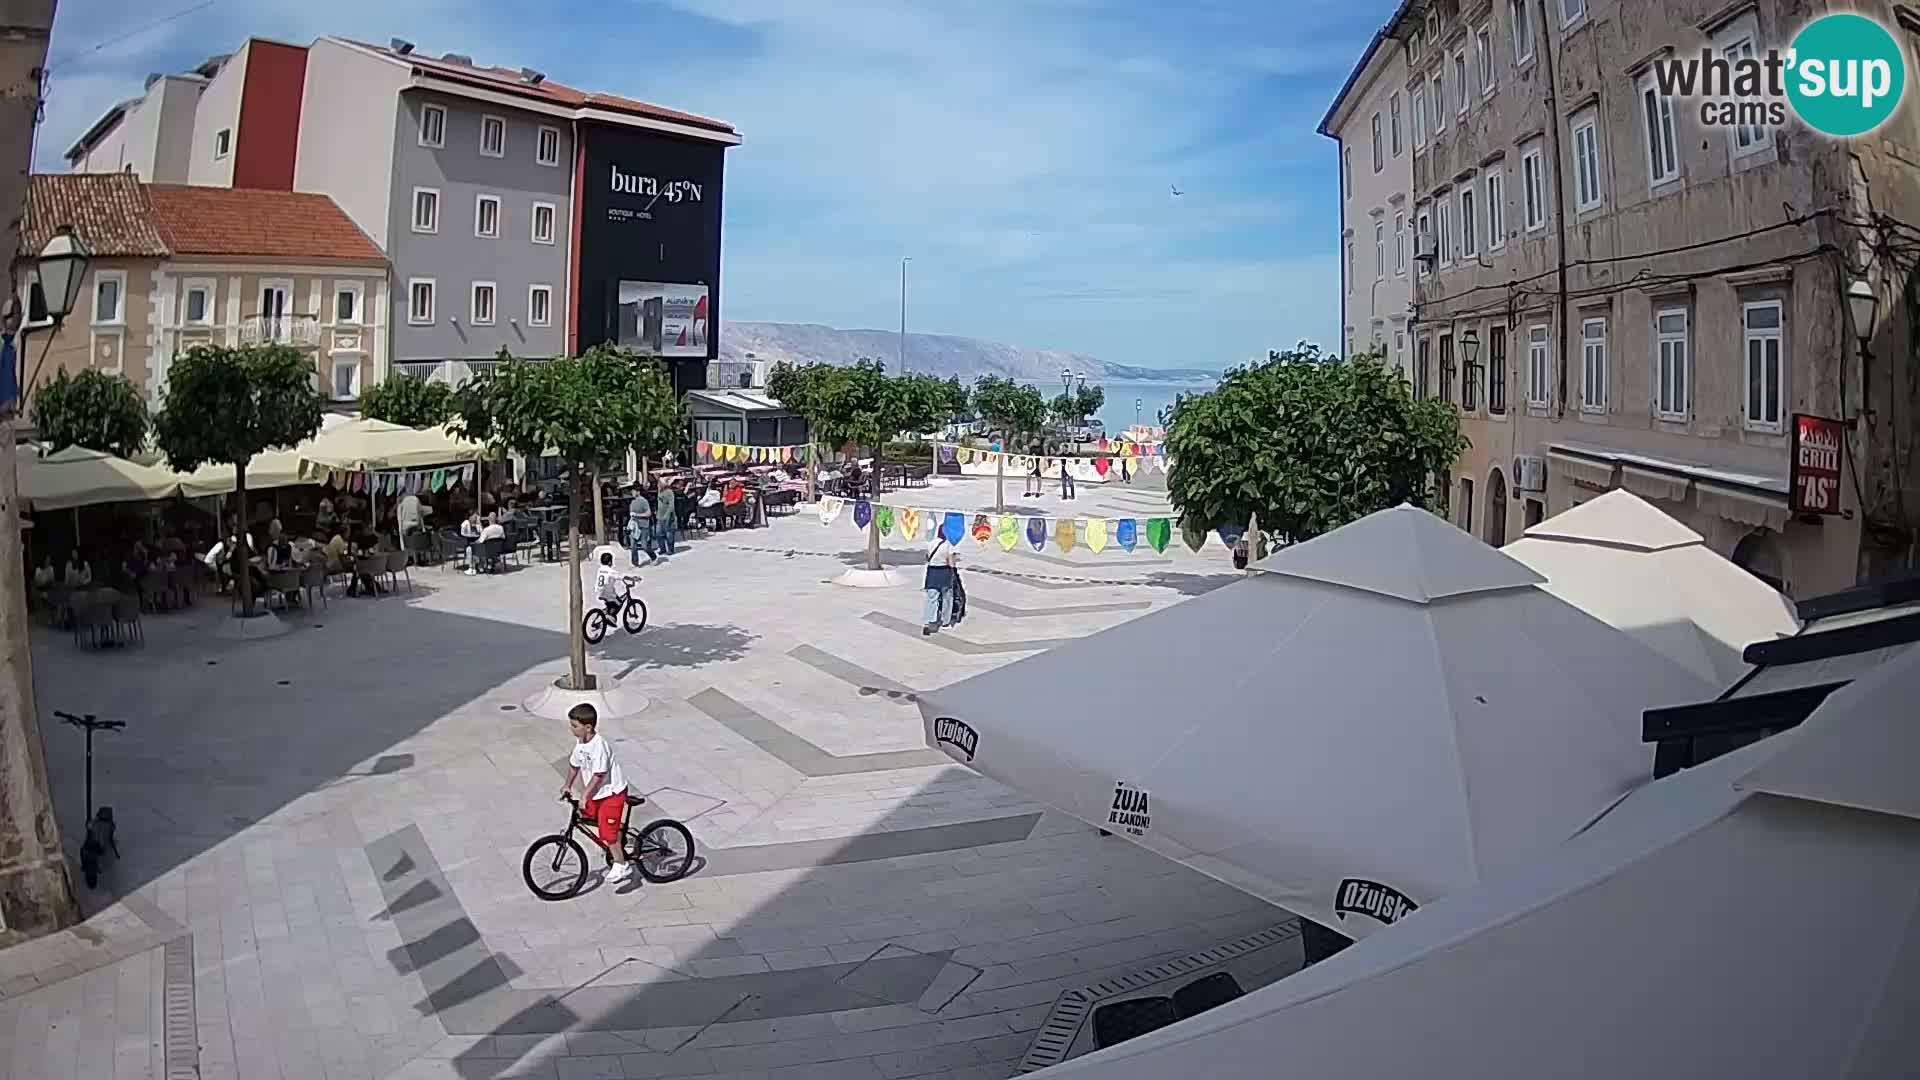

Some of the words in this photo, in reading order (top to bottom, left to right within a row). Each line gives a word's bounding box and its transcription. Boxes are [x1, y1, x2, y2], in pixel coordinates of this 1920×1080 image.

[611, 165, 657, 196] bura
[608, 208, 634, 217] BOUTIQUE
[1799, 447, 1838, 471] GRILL
[937, 719, 974, 752] Ožujsko
[1112, 781, 1148, 814] ŽUJA
[1109, 811, 1118, 823] JE
[1118, 812, 1151, 829] ZAKON!
[1342, 881, 1409, 922] Ožujsk
